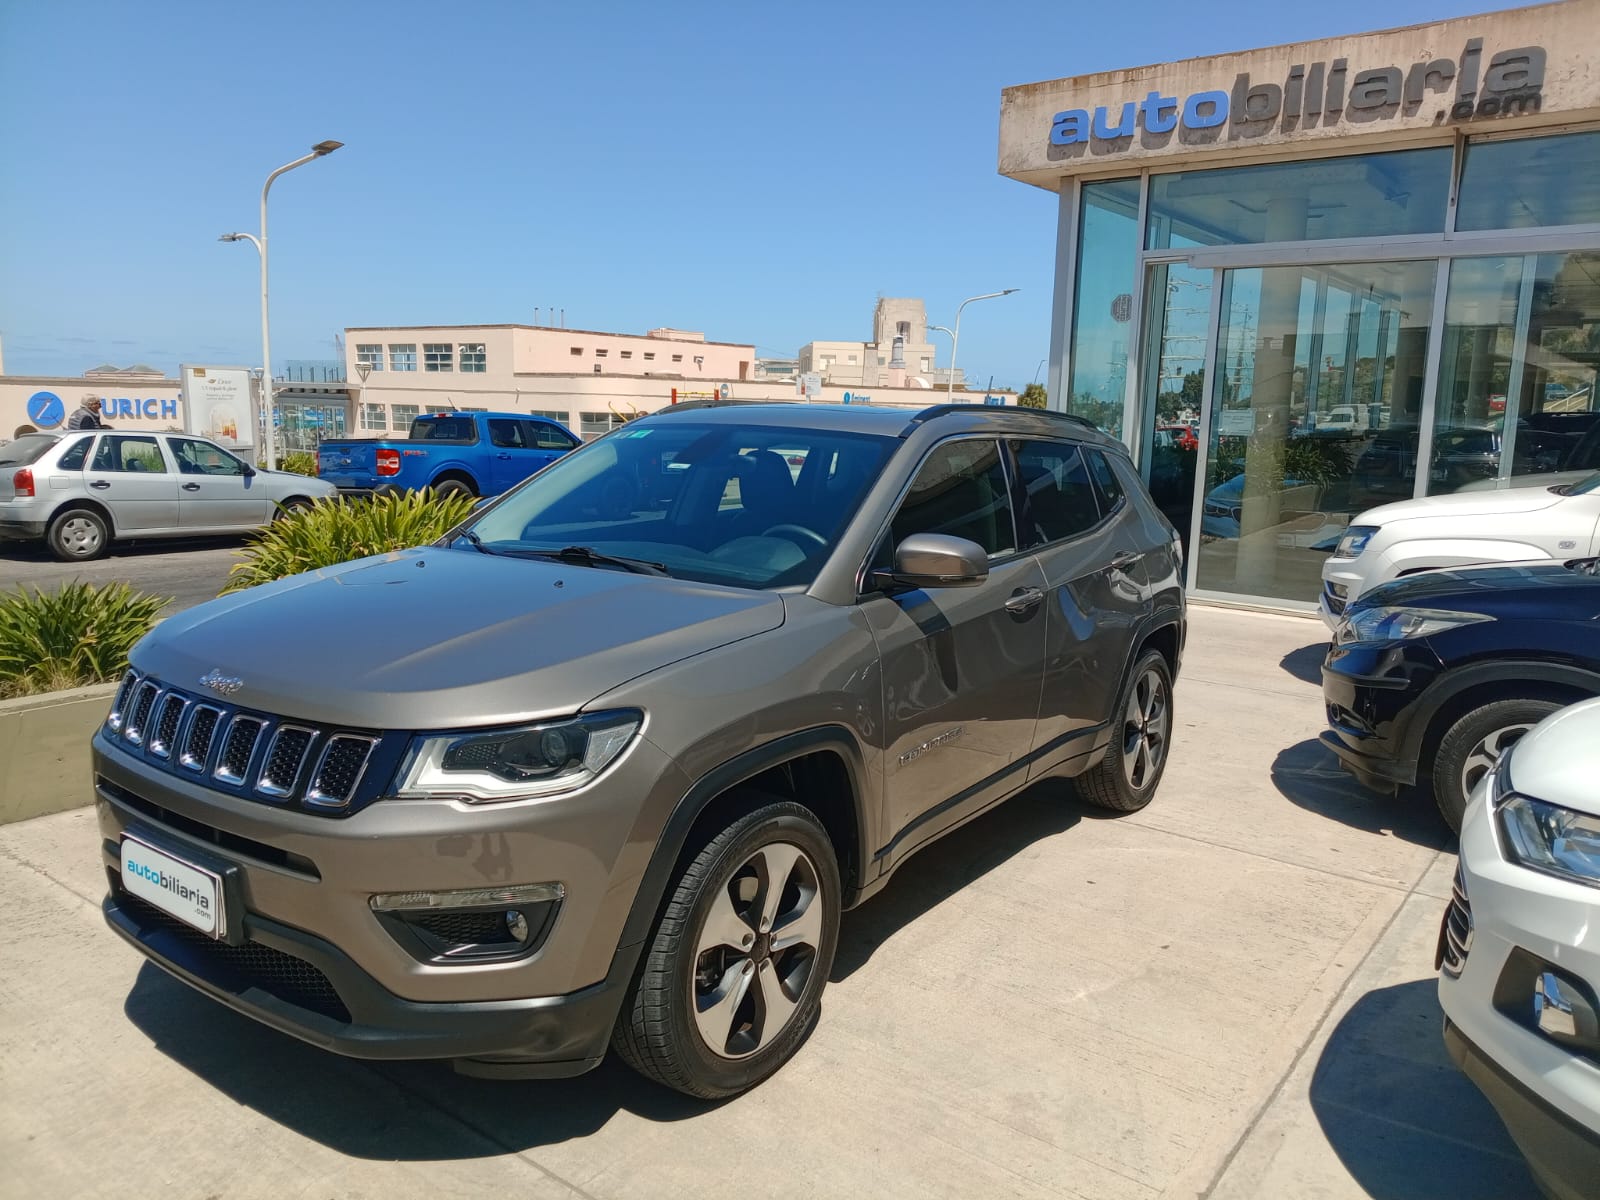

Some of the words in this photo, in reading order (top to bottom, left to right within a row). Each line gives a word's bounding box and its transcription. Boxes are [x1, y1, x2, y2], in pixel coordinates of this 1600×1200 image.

[1050, 37, 1546, 146] autobiliaria
[99, 398, 177, 418] URICH
[127, 859, 209, 909] autobiliaria
[194, 908, 211, 920] .com
